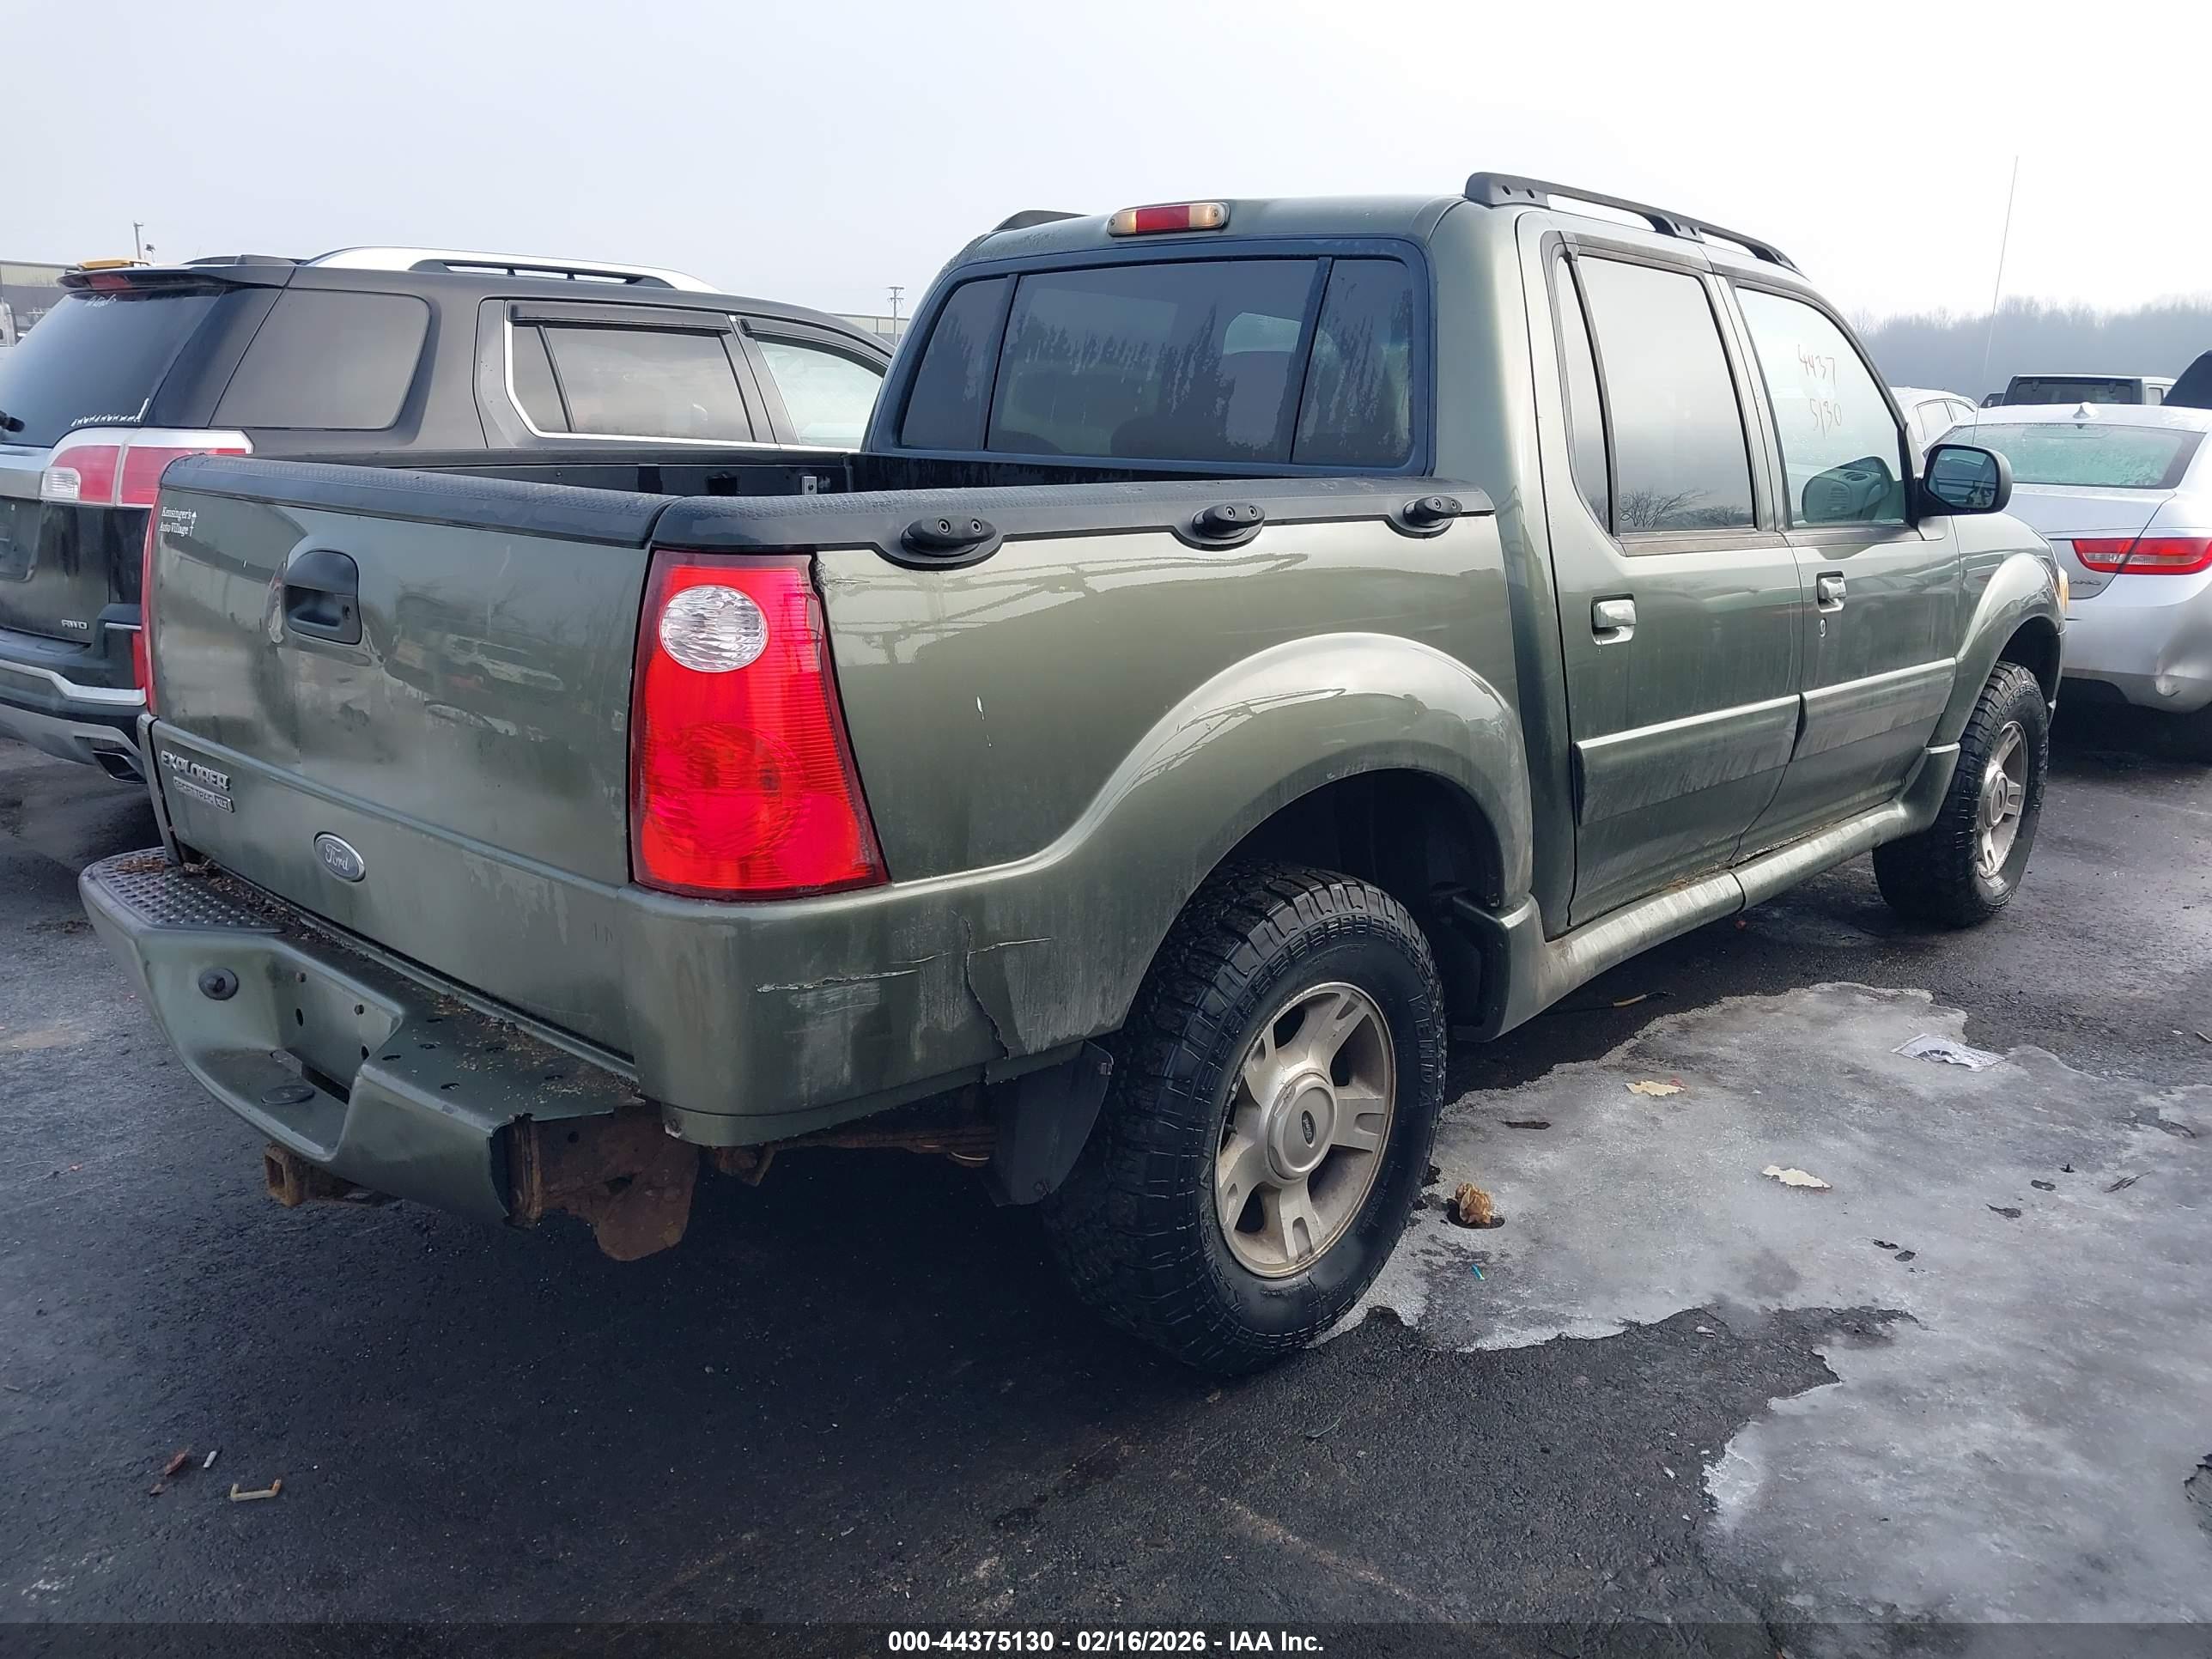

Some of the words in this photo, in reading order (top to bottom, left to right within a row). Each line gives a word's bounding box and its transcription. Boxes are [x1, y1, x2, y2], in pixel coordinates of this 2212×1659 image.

[1797, 343, 1836, 386] 4437
[1809, 398, 1842, 439] 5130
[161, 750, 229, 789] EXPLORER
[325, 843, 349, 871] Ford
[1408, 994, 1436, 1107] KENDA
